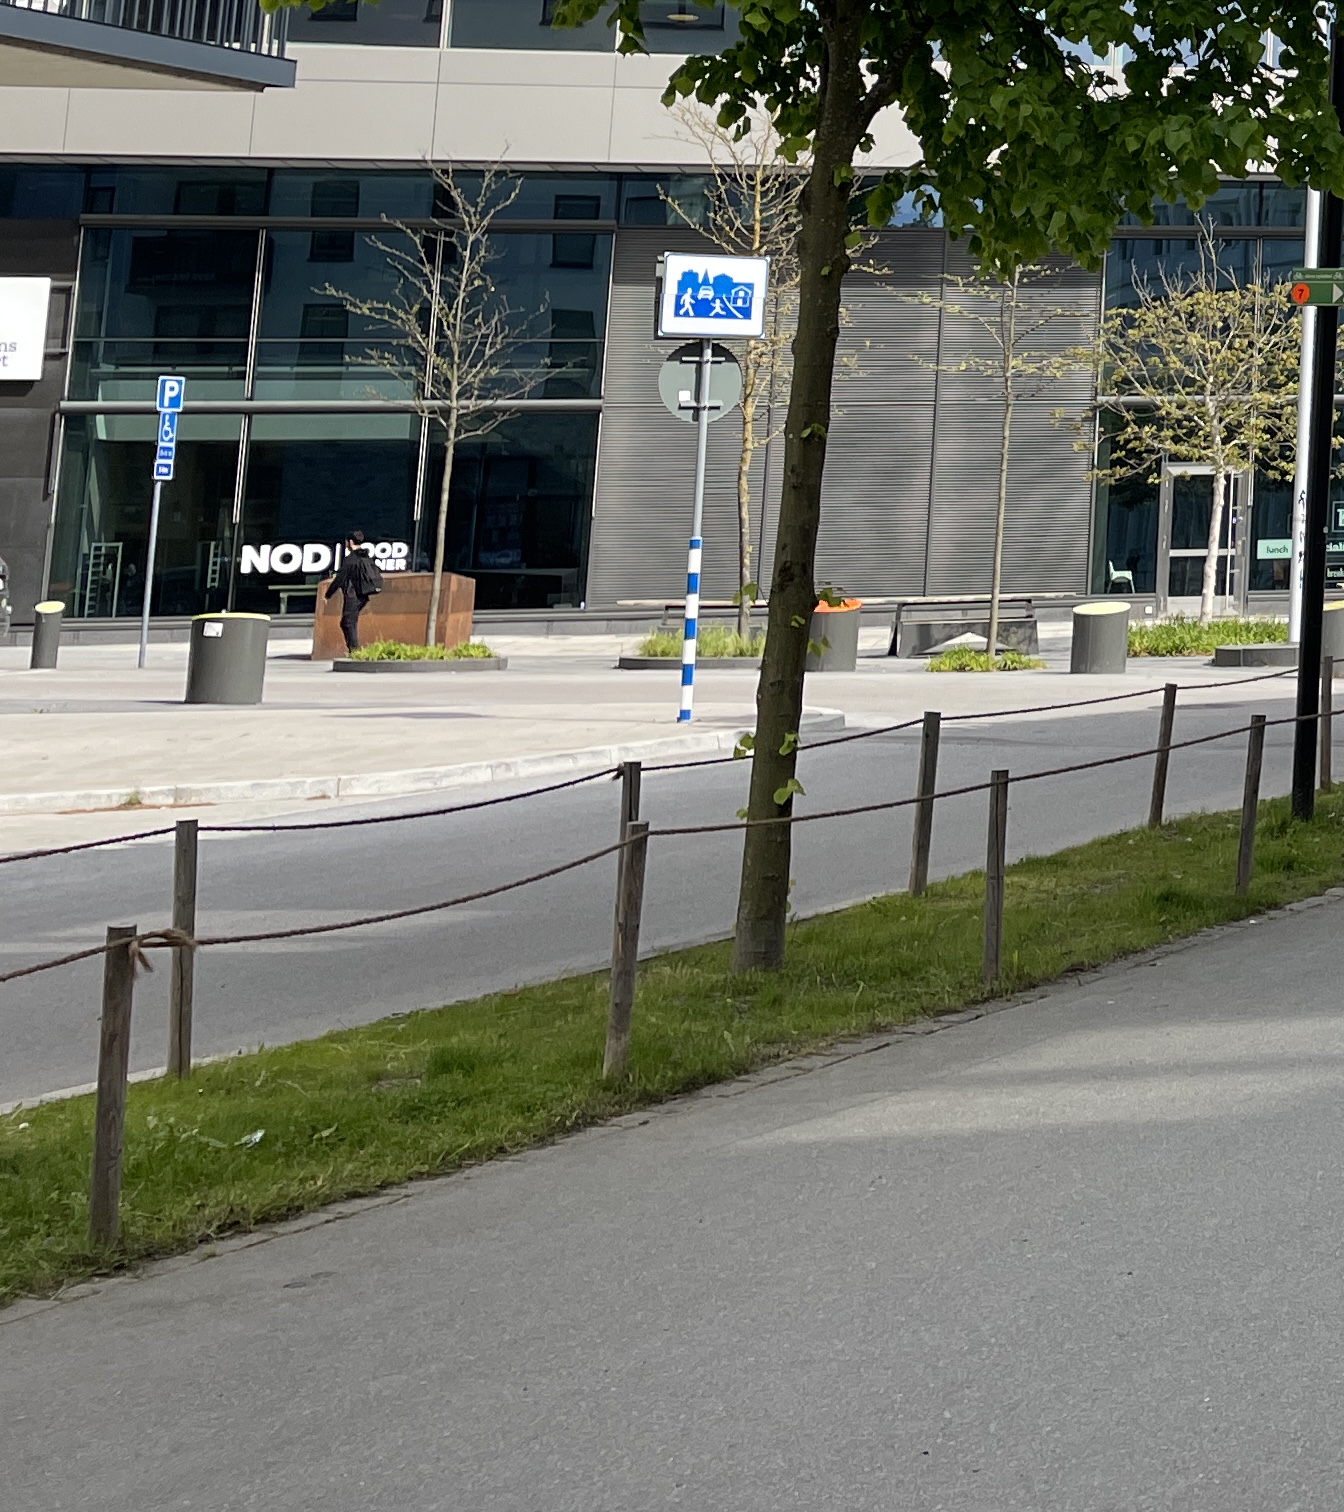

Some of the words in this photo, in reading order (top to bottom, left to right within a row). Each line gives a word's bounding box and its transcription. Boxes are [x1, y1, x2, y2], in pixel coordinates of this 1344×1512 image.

[1298, 289, 1304, 299] 7
[163, 380, 179, 407] P
[240, 543, 333, 574] NOD
[1266, 545, 1289, 554] lunch
